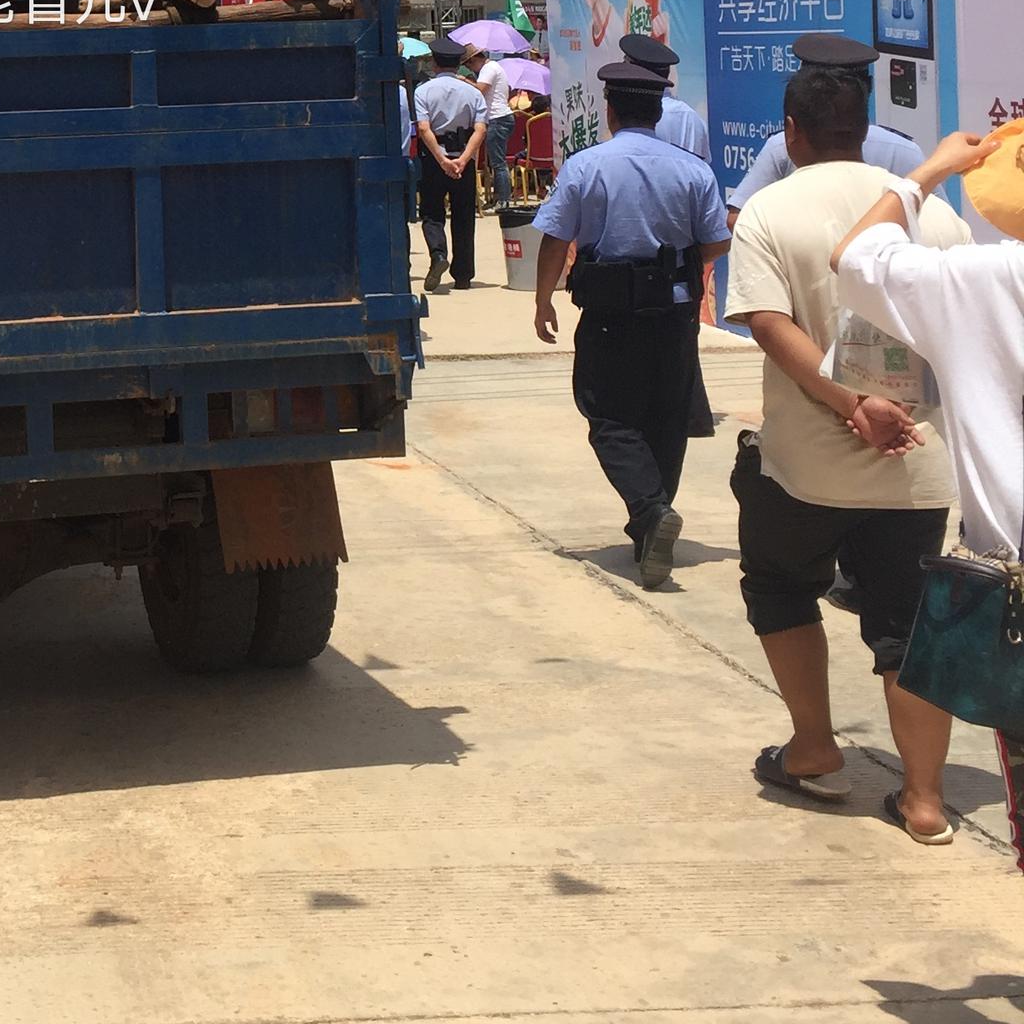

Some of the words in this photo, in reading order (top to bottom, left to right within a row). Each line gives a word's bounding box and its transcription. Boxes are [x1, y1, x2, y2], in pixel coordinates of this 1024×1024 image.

[720, 44, 802, 72] 广告天下·踏足
[559, 111, 600, 162] 大爆发
